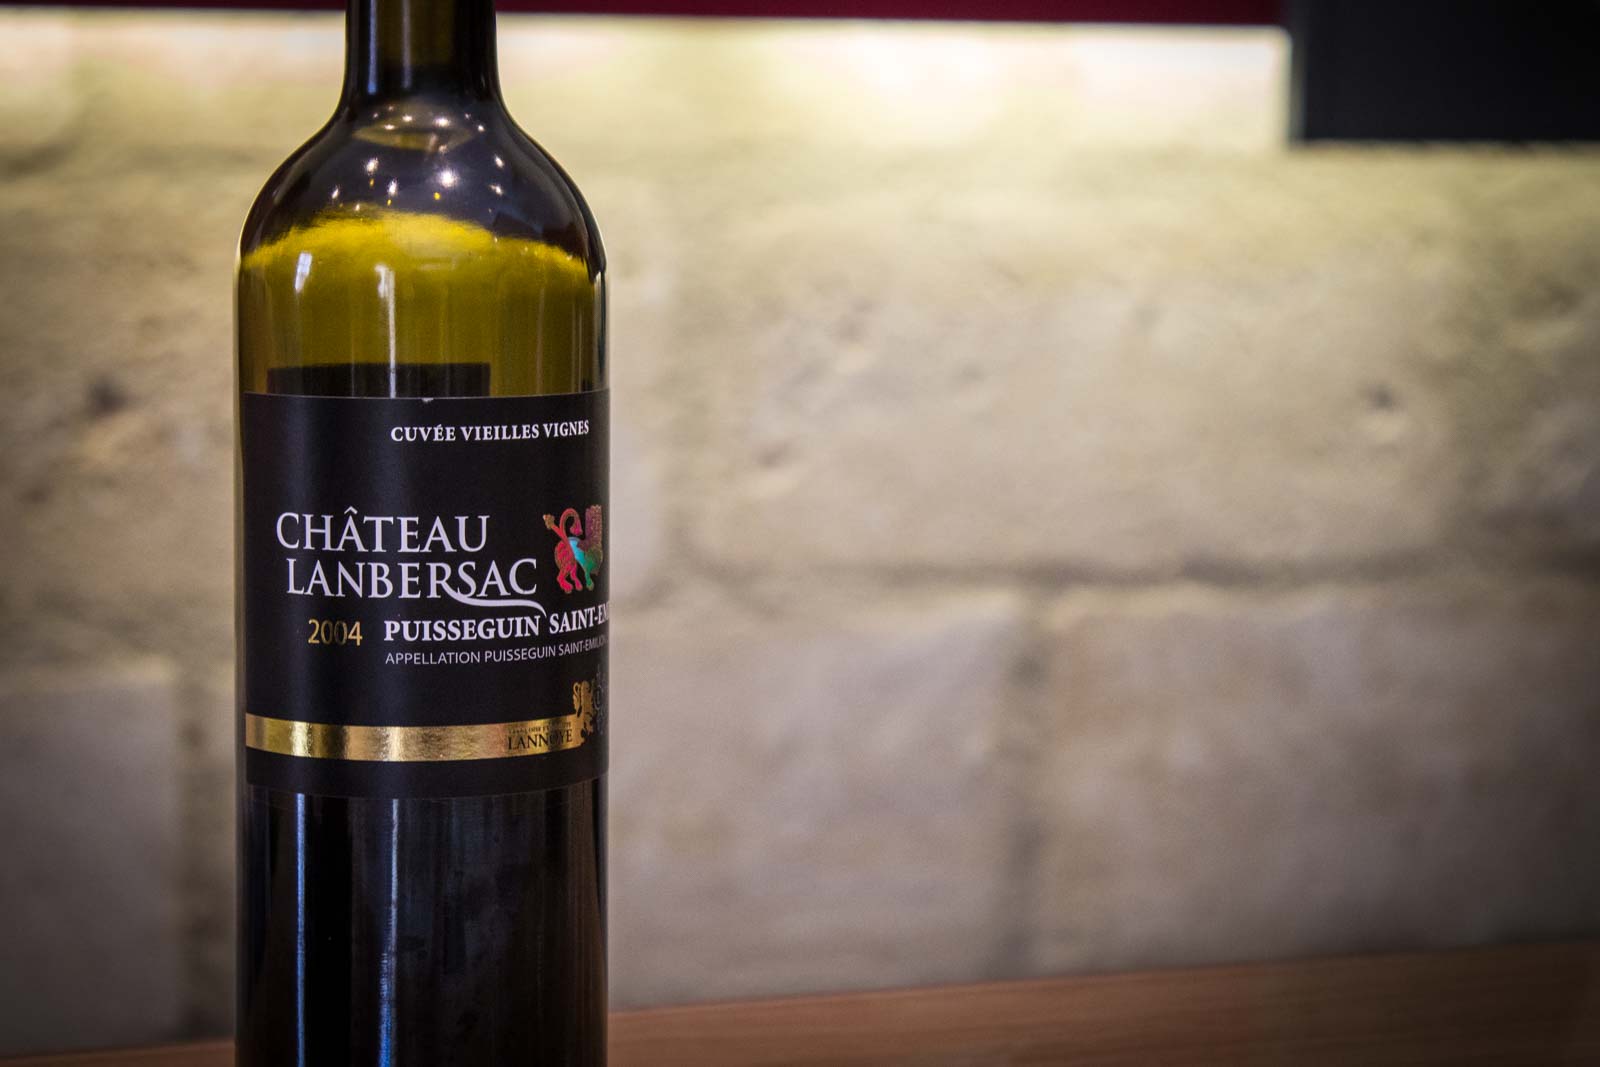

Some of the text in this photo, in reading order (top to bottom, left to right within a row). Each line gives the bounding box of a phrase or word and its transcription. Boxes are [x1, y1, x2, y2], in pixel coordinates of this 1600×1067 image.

[390, 419, 590, 441] CUVÉE VIEILLES VIGNES
[276, 506, 490, 553] CHÂTEAU
[286, 557, 546, 616] LANBERSAC
[307, 618, 363, 646] 2004
[383, 615, 541, 641] PUISSEGUIN
[385, 652, 481, 665] APPELLATION
[484, 646, 556, 663] PUISSEGUIN
[507, 728, 573, 750] LANNOYE
